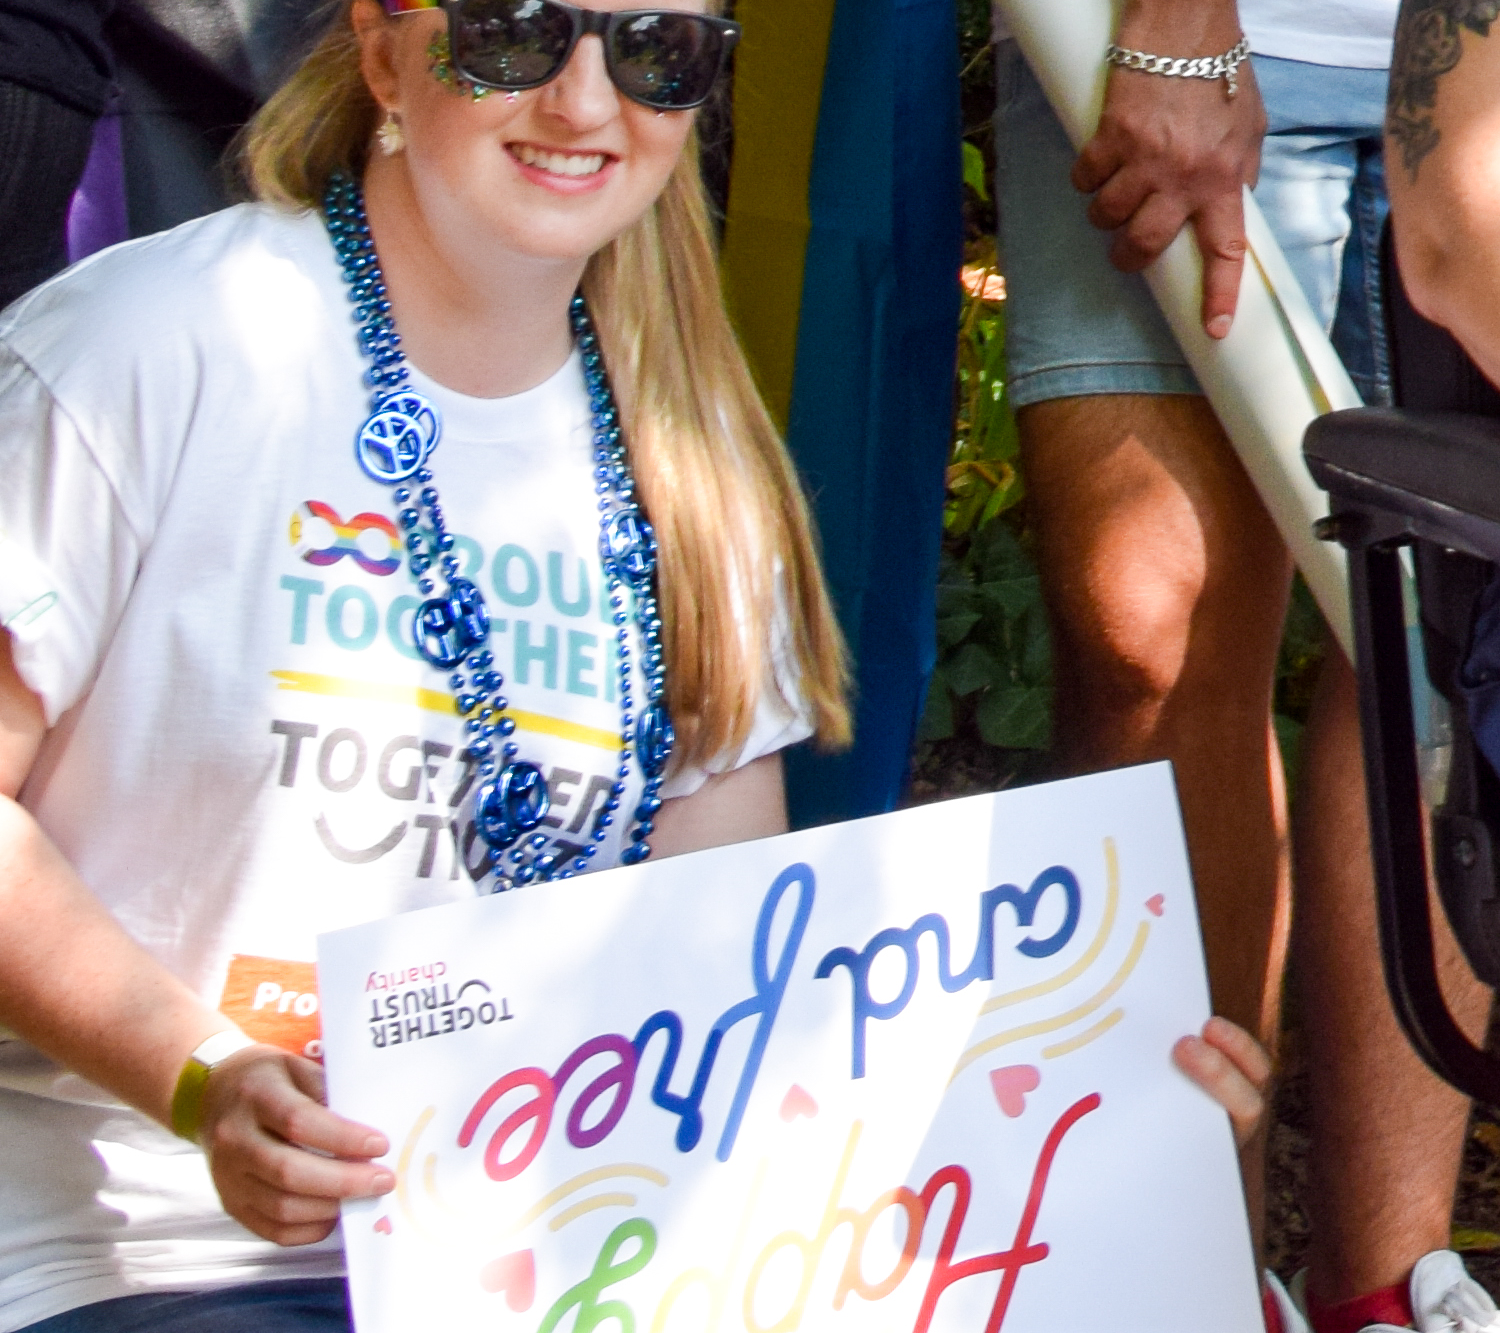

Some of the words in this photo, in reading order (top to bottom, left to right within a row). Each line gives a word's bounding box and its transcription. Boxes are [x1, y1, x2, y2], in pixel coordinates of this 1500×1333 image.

[366, 960, 447, 993] charity
[814, 863, 1083, 1079] and
[368, 983, 460, 1024] TRUST
[371, 995, 514, 1049] TOGETHER
[457, 861, 817, 1184] free
